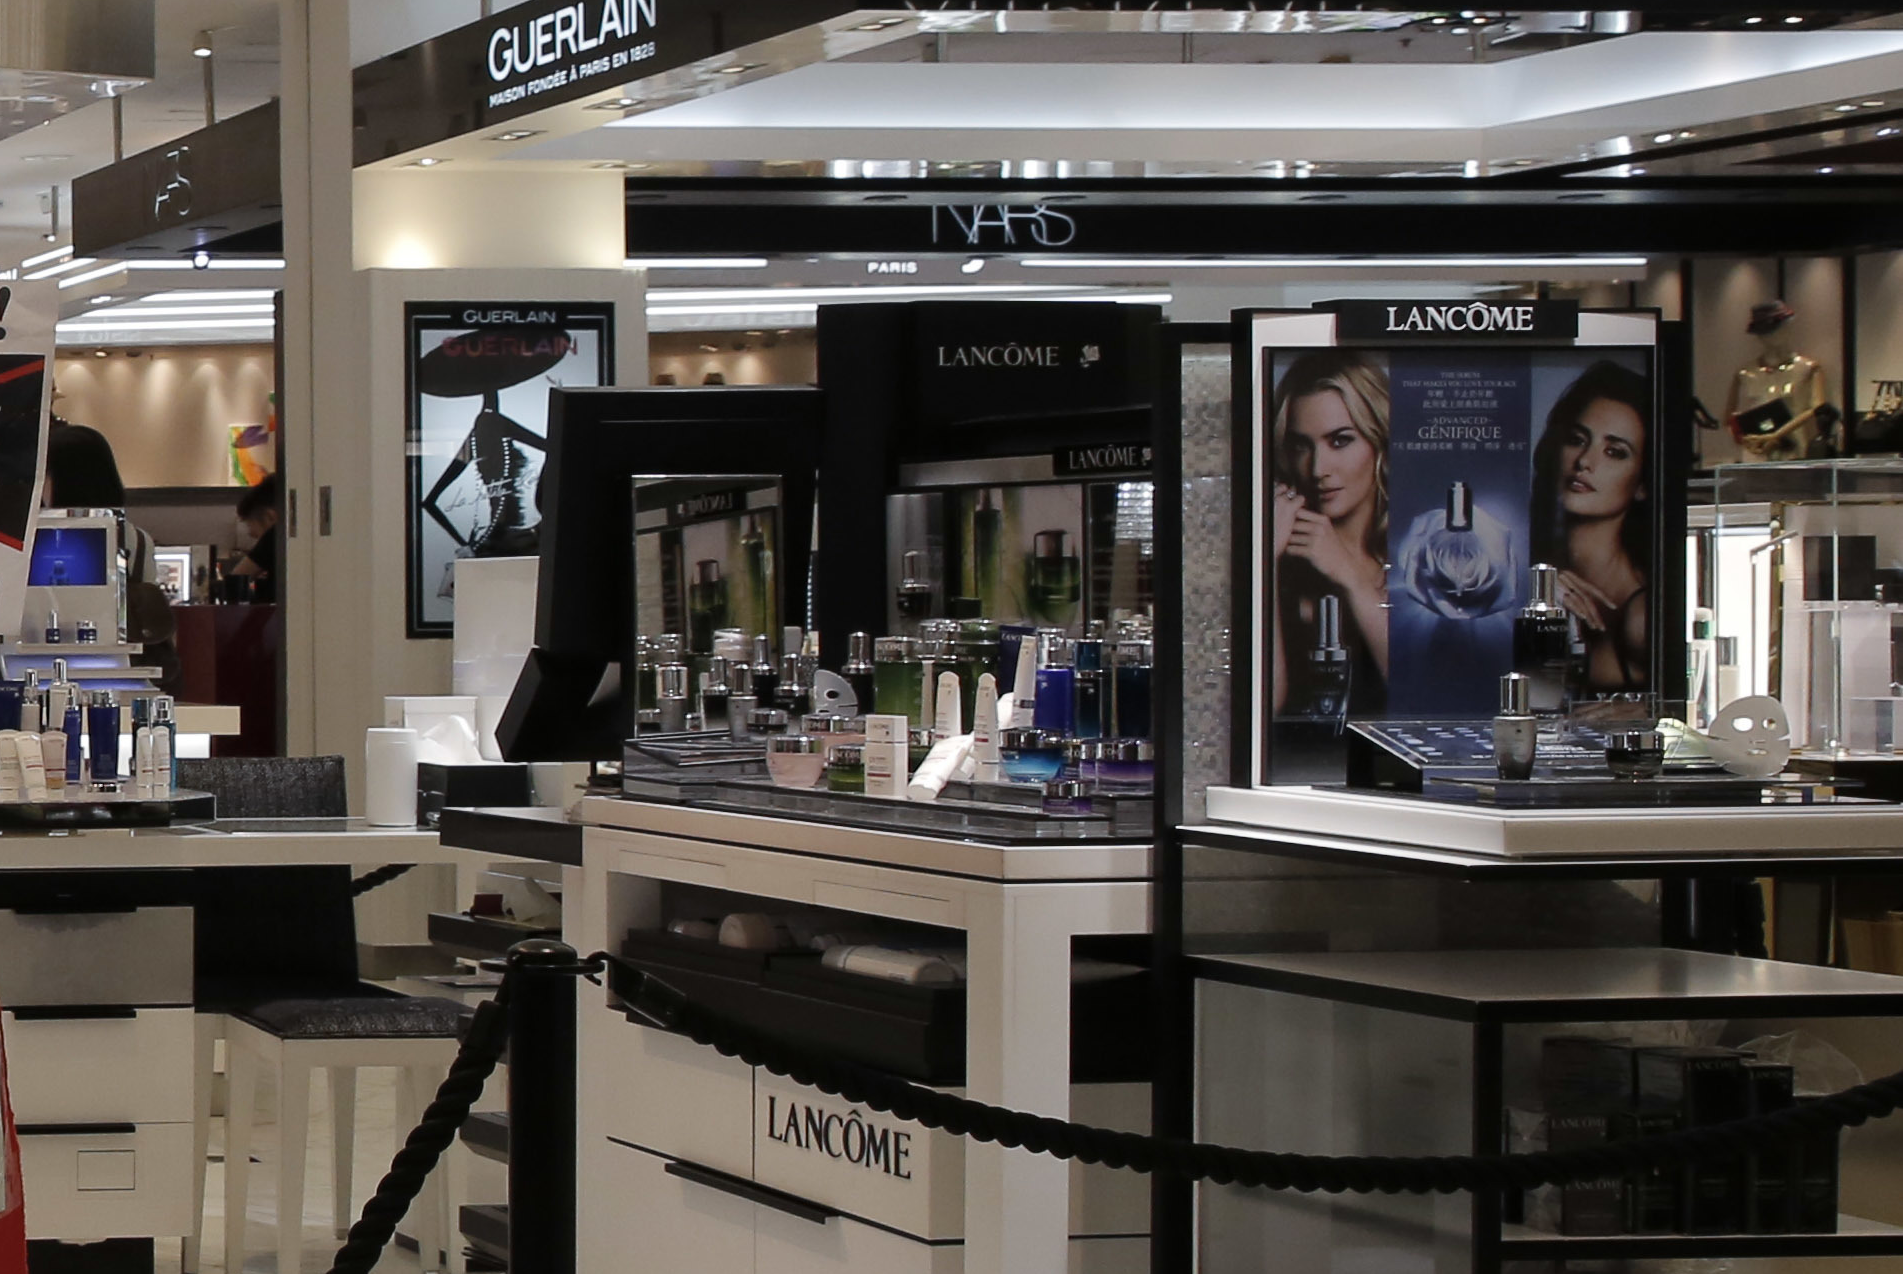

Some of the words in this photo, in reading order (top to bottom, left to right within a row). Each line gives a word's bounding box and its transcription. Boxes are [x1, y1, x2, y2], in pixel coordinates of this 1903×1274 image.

[489, 84, 527, 109] MAISON
[527, 69, 568, 96] FONDÉE
[579, 55, 611, 79] PARIS
[612, 49, 629, 69] EN
[630, 41, 656, 62] 1828
[931, 204, 1077, 246] NARS
[867, 261, 918, 274] PARIS
[463, 309, 557, 324] GUERLAIN
[1386, 301, 1534, 331] LANCÔME
[442, 336, 579, 357] GUERLAIN
[938, 342, 1060, 366] LANCÔME
[1417, 423, 1502, 442] GÉNIFIQUE
[1069, 444, 1138, 470] LANCÔME
[767, 1095, 912, 1180] LANCÔME
